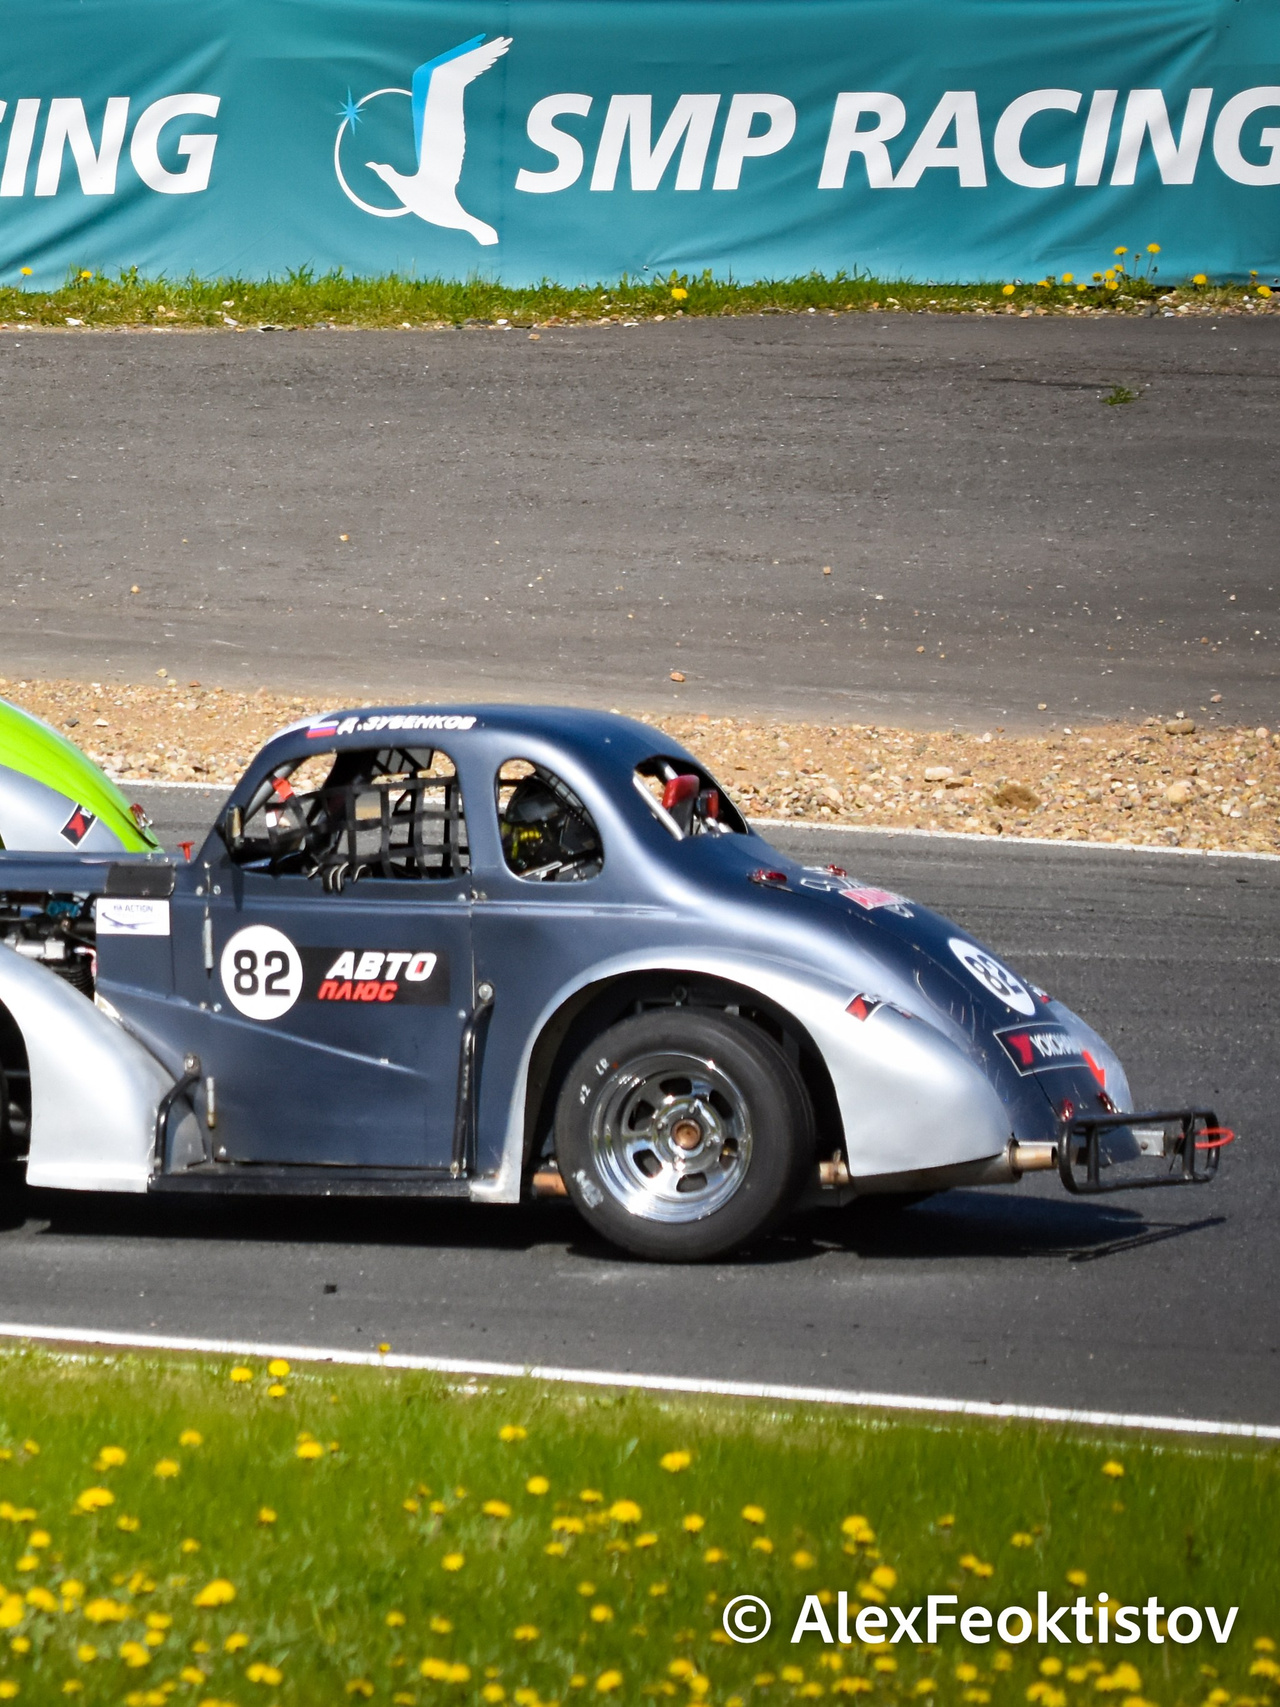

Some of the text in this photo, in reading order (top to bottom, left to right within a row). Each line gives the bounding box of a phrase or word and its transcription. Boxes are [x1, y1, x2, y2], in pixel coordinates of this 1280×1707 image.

[515, 86, 1280, 193] SMP RACING
[234, 949, 290, 996] 82
[325, 951, 437, 982] АВТО
[964, 954, 1024, 996] 82
[318, 980, 398, 1002] ПЛЮС
